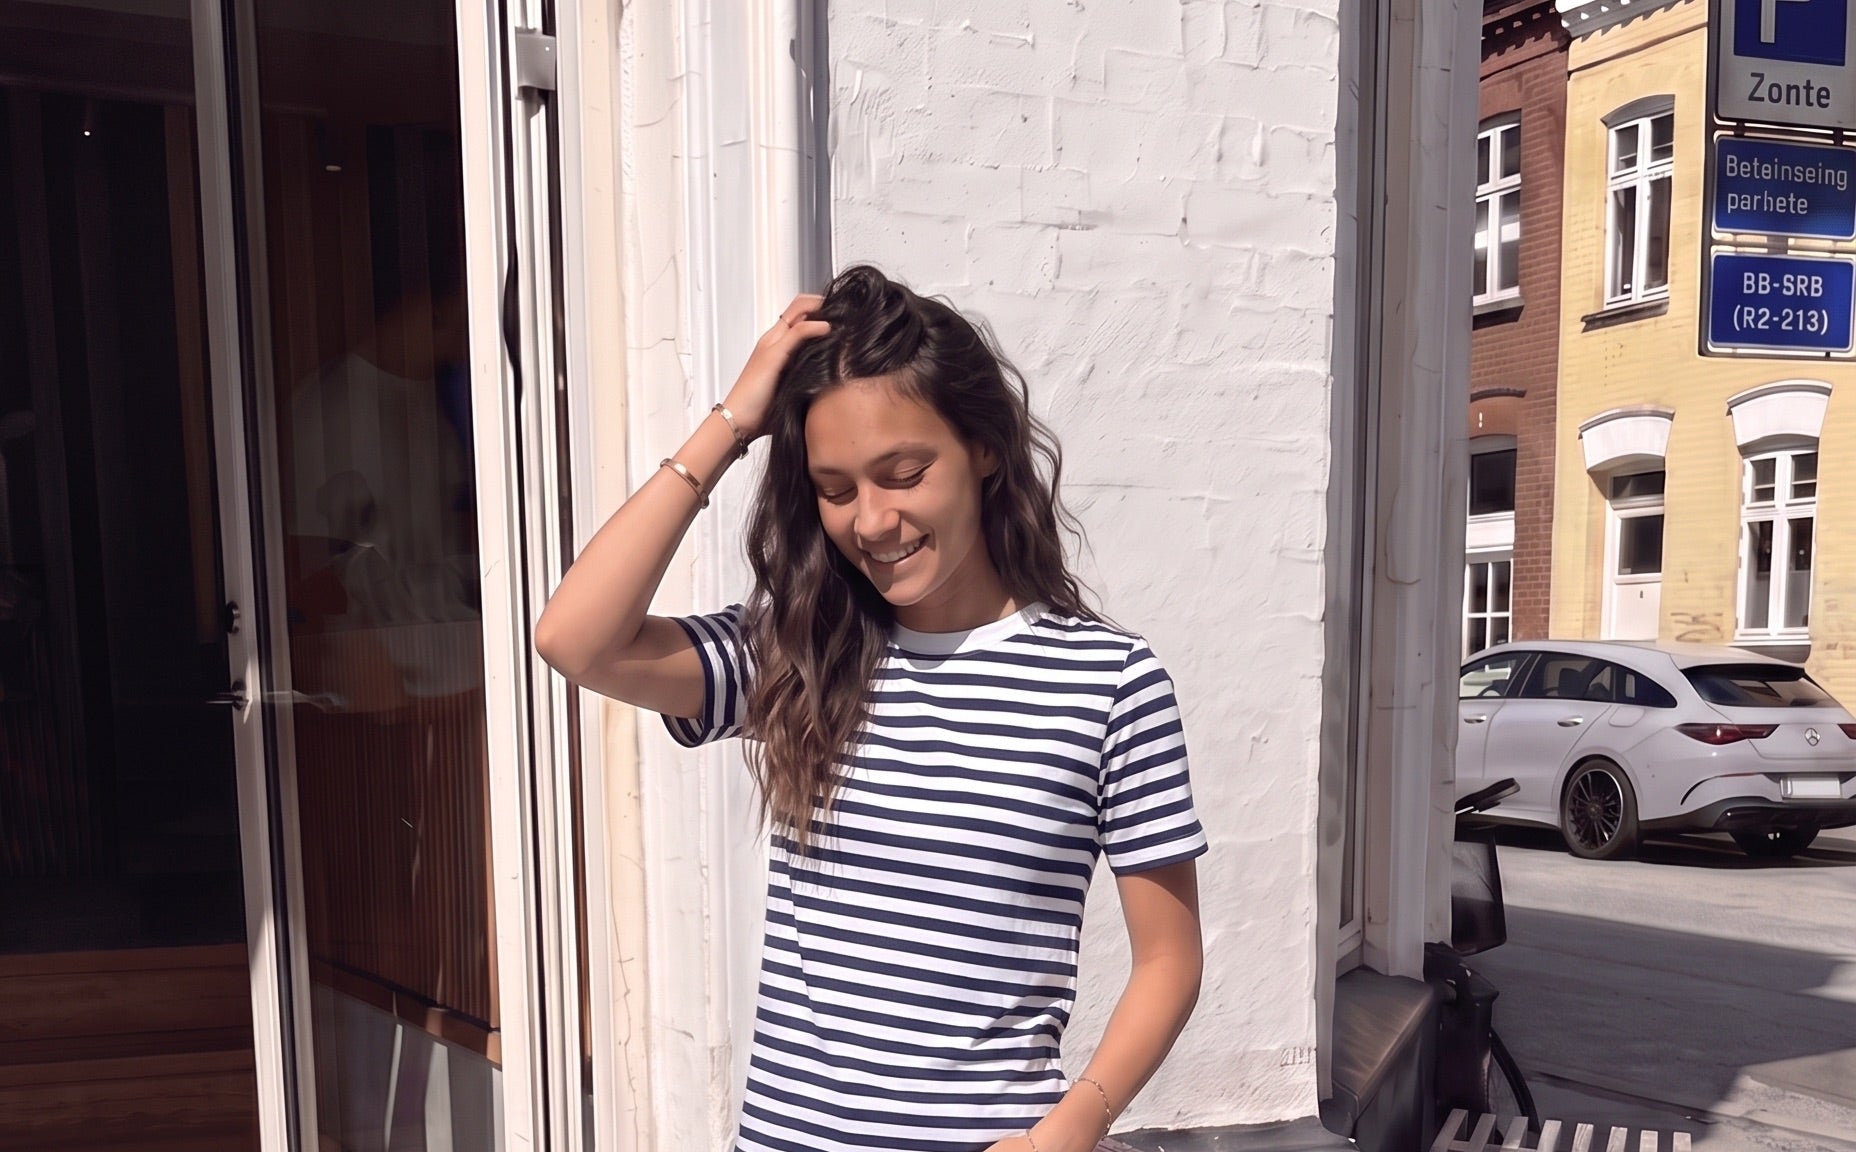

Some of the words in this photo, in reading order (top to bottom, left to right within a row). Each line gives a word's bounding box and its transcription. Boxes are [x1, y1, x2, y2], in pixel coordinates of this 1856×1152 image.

[1748, 72, 1831, 109] Zonte
[1743, 272, 1823, 297] BB-SRB
[1733, 304, 1829, 336] (R2-213)
